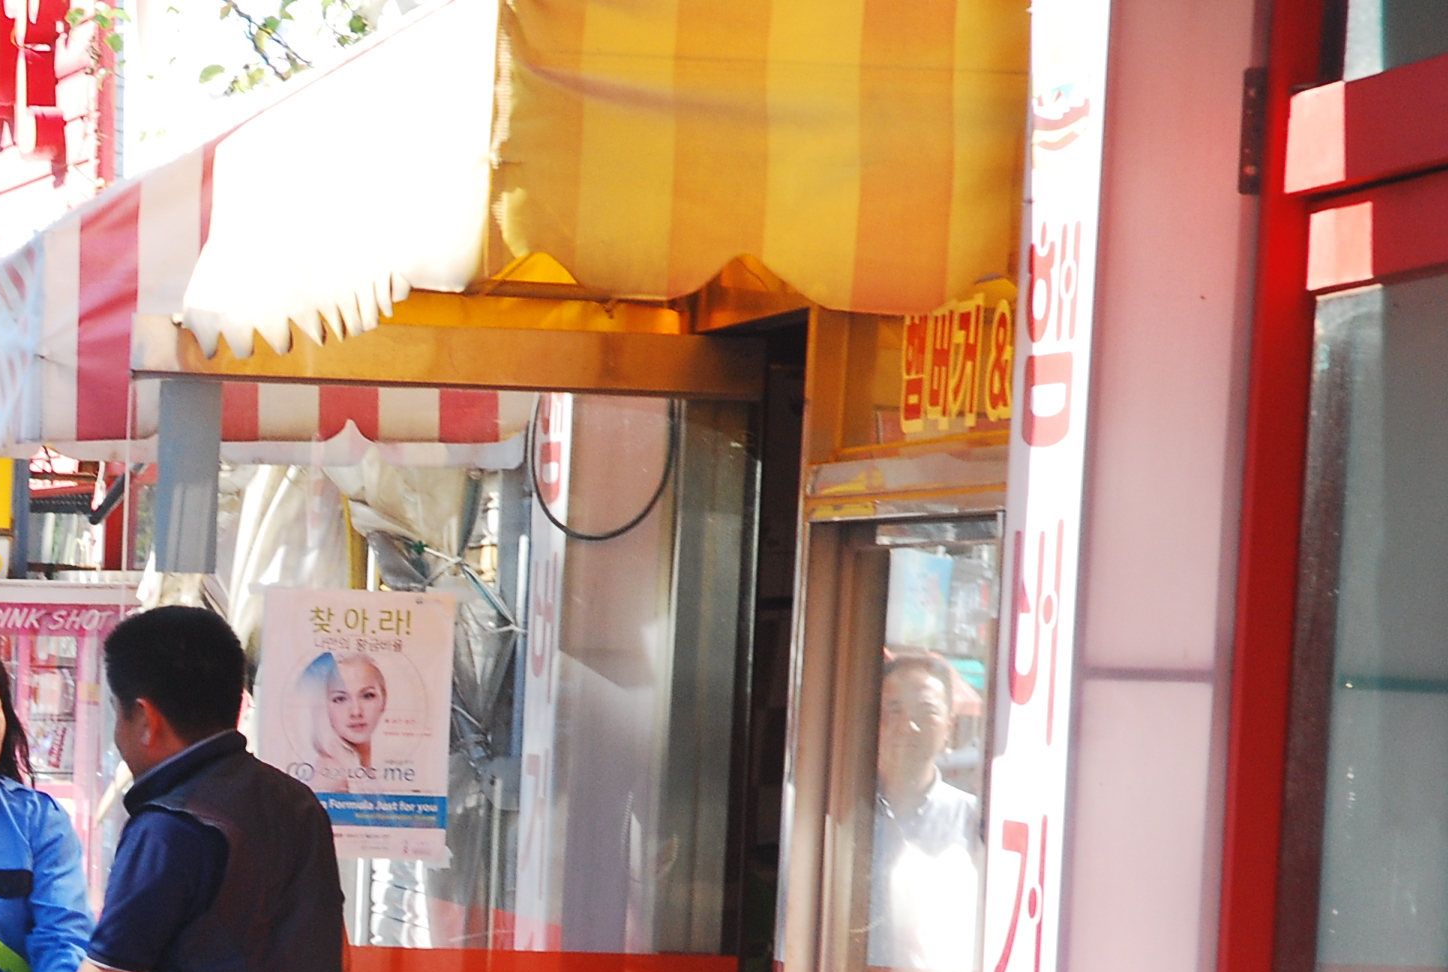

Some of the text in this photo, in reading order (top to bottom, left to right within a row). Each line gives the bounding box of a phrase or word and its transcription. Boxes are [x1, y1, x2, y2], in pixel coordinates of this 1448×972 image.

[48, 609, 114, 632] SHOT
[309, 606, 413, 636] 찾.아.라!
[383, 768, 416, 782] me
[329, 798, 374, 811] Formula
[417, 803, 439, 814] you
